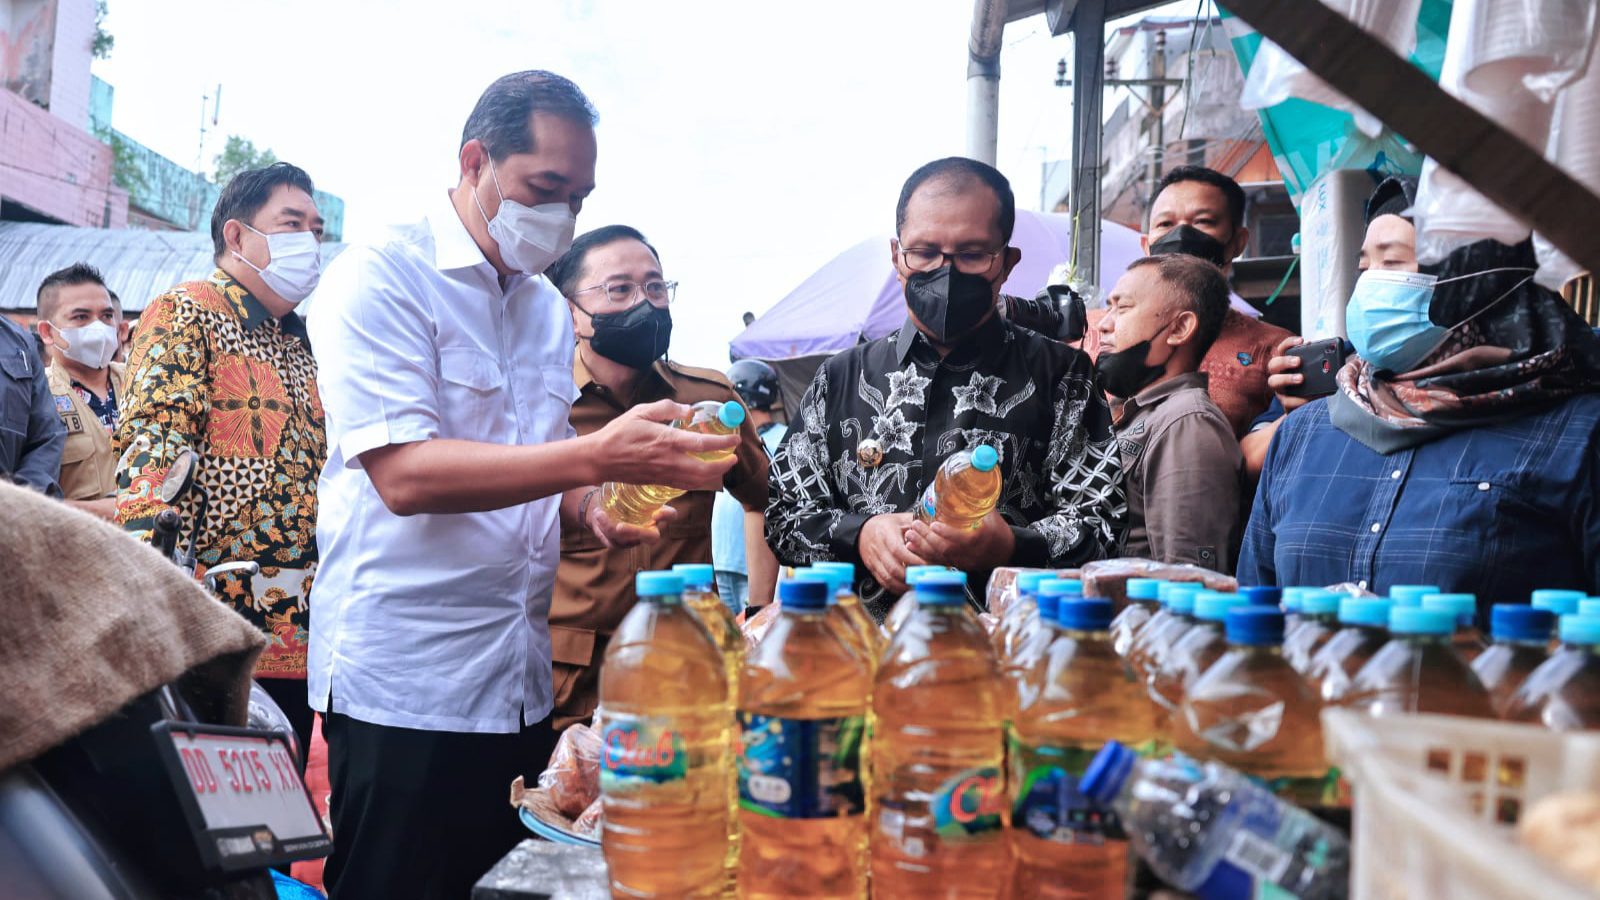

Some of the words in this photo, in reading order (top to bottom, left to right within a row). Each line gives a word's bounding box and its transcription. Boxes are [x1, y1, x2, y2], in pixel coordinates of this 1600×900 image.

[605, 729, 675, 769] Club
[180, 748, 217, 794] DD
[218, 749, 272, 793] 5215
[268, 751, 300, 791] XX
